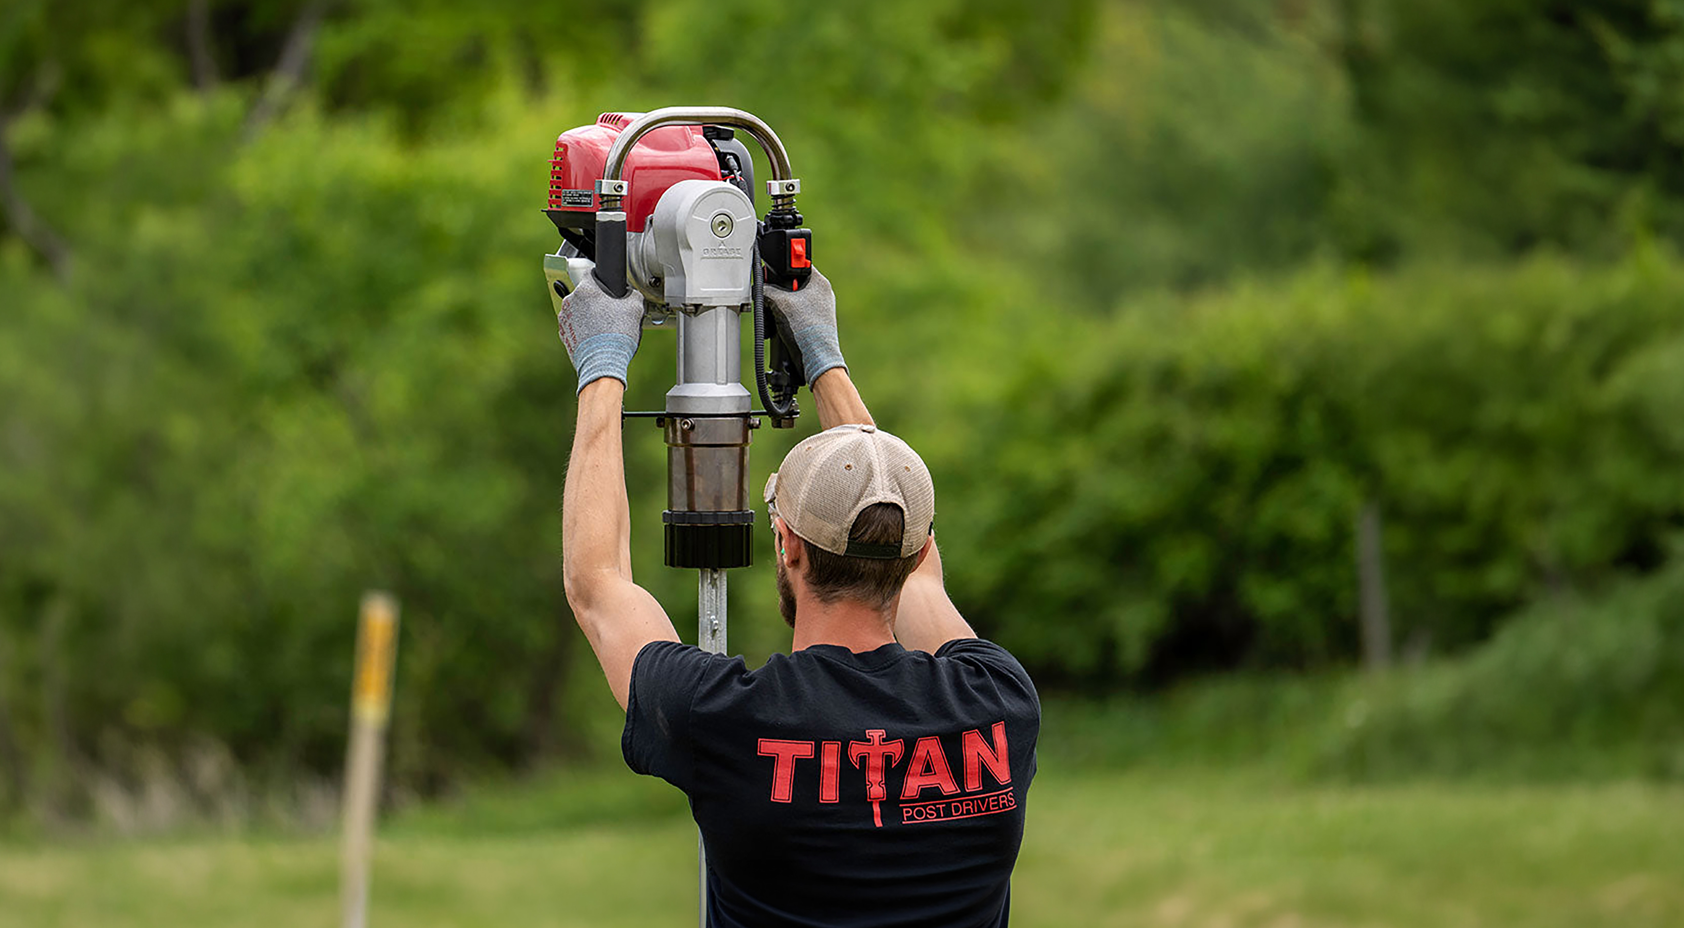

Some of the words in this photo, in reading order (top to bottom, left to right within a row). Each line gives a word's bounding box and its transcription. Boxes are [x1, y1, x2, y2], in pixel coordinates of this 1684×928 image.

[757, 721, 1012, 827] TITAN
[903, 804, 946, 822] POST
[951, 792, 1016, 817] DRIVERS
